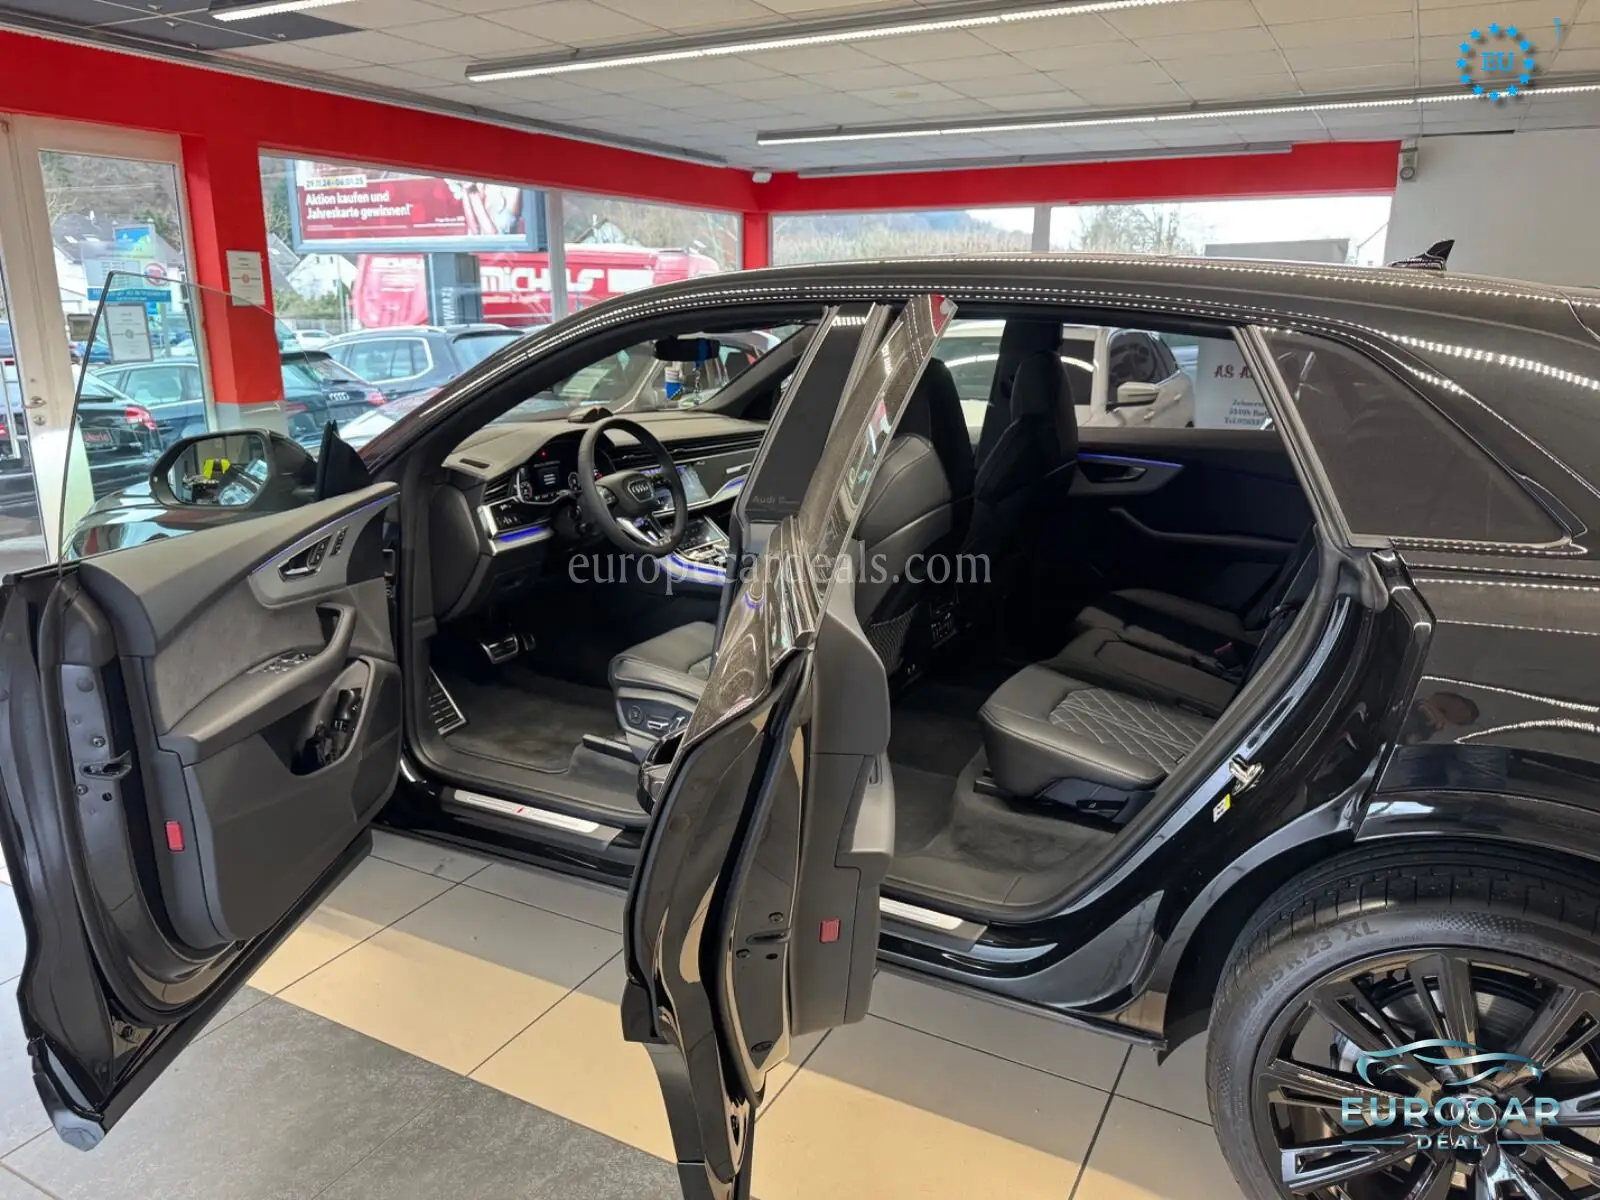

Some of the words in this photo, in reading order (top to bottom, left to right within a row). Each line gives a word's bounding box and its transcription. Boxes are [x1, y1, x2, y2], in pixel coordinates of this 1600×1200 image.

[305, 192, 336, 206] Aktion
[336, 191, 370, 205] kaufen
[370, 190, 390, 202] und
[306, 205, 360, 220] Jahreskarte
[1214, 364, 1234, 378] AS
[752, 495, 776, 505] Audi
